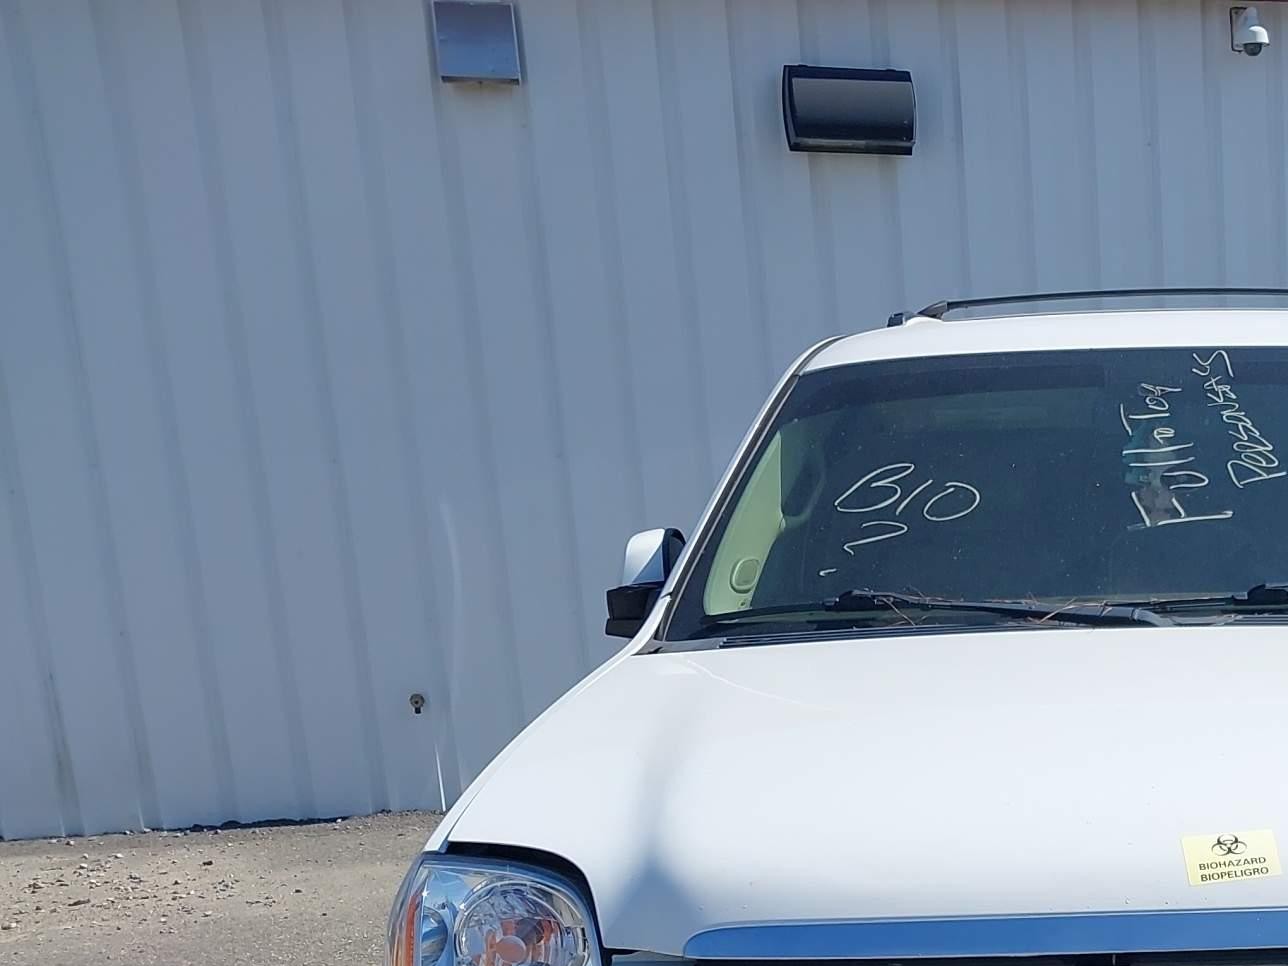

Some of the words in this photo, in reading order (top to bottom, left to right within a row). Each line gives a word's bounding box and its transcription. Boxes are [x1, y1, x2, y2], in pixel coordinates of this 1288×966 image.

[834, 463, 981, 522] BIO
[1198, 856, 1267, 871] BIOHAZARD
[1200, 866, 1270, 882] BIOPELIGRO
